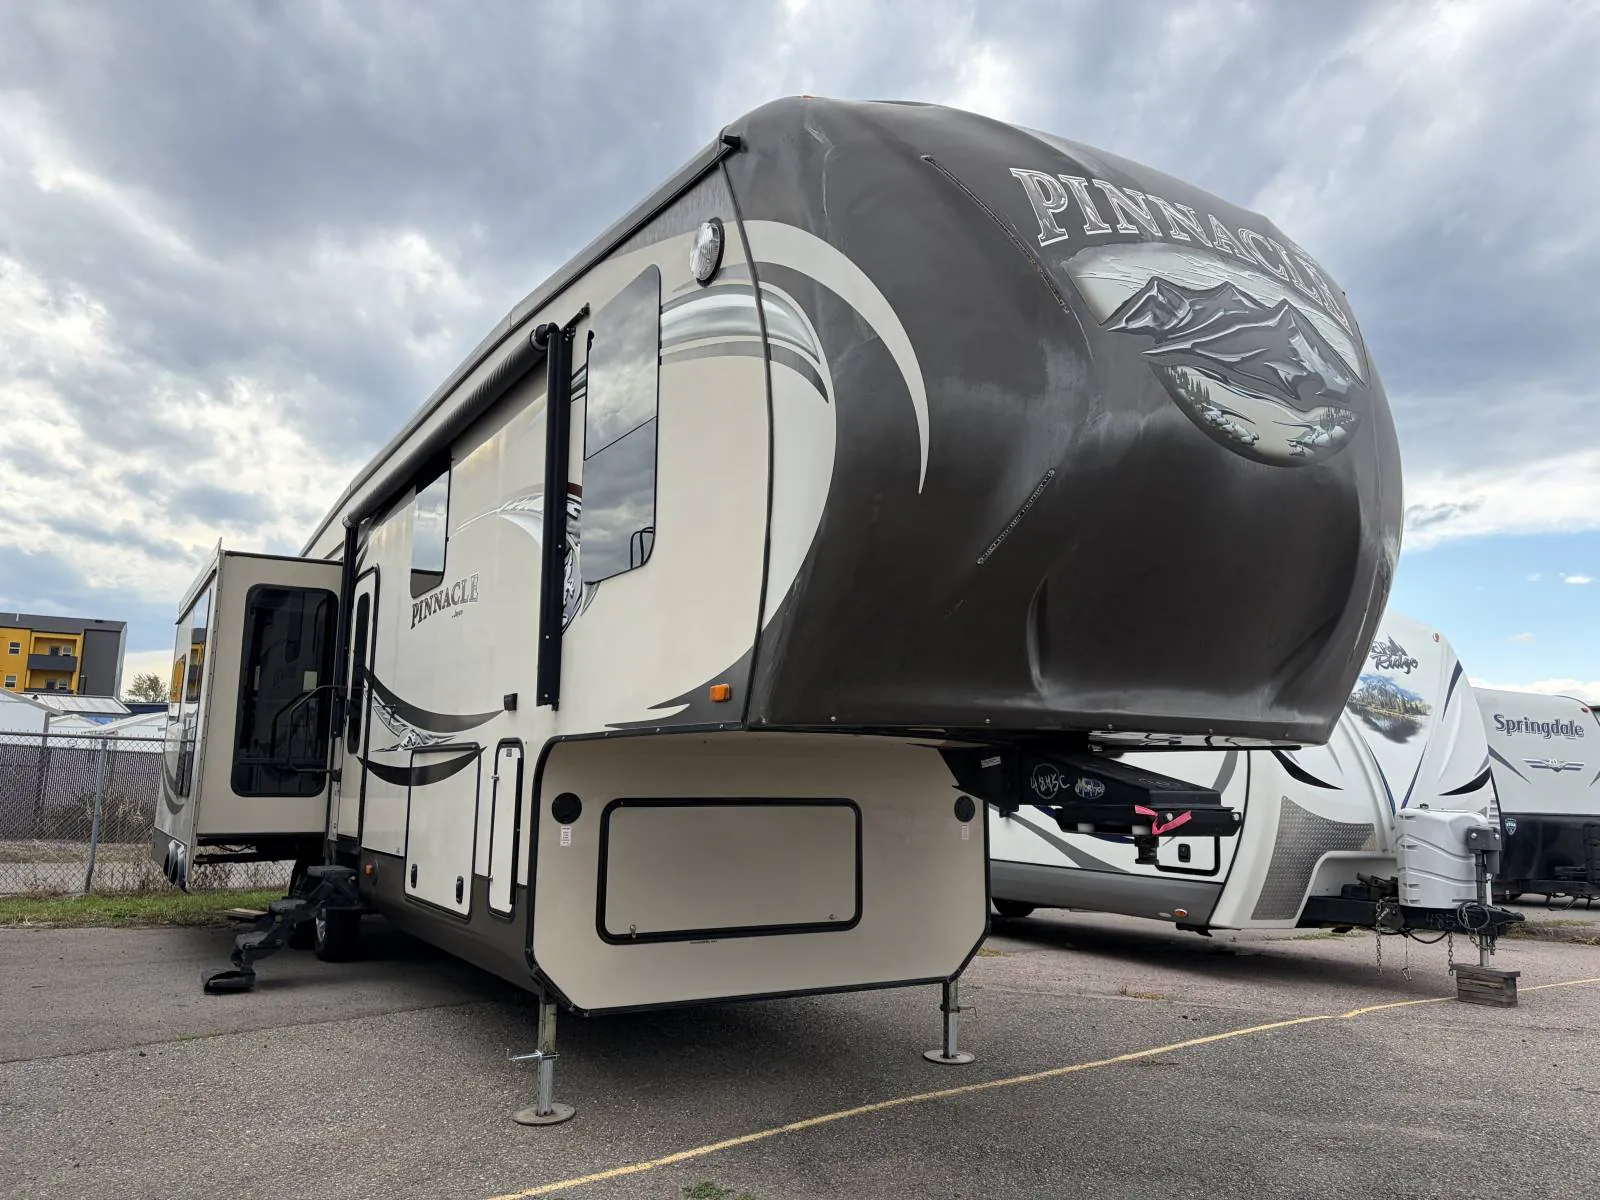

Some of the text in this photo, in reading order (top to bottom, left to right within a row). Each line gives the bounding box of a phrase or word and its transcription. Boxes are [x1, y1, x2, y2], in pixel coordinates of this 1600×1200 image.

[1009, 167, 1354, 337] PINNACLE
[410, 573, 479, 630] PINNACLE
[1493, 713, 1585, 740] Springdale
